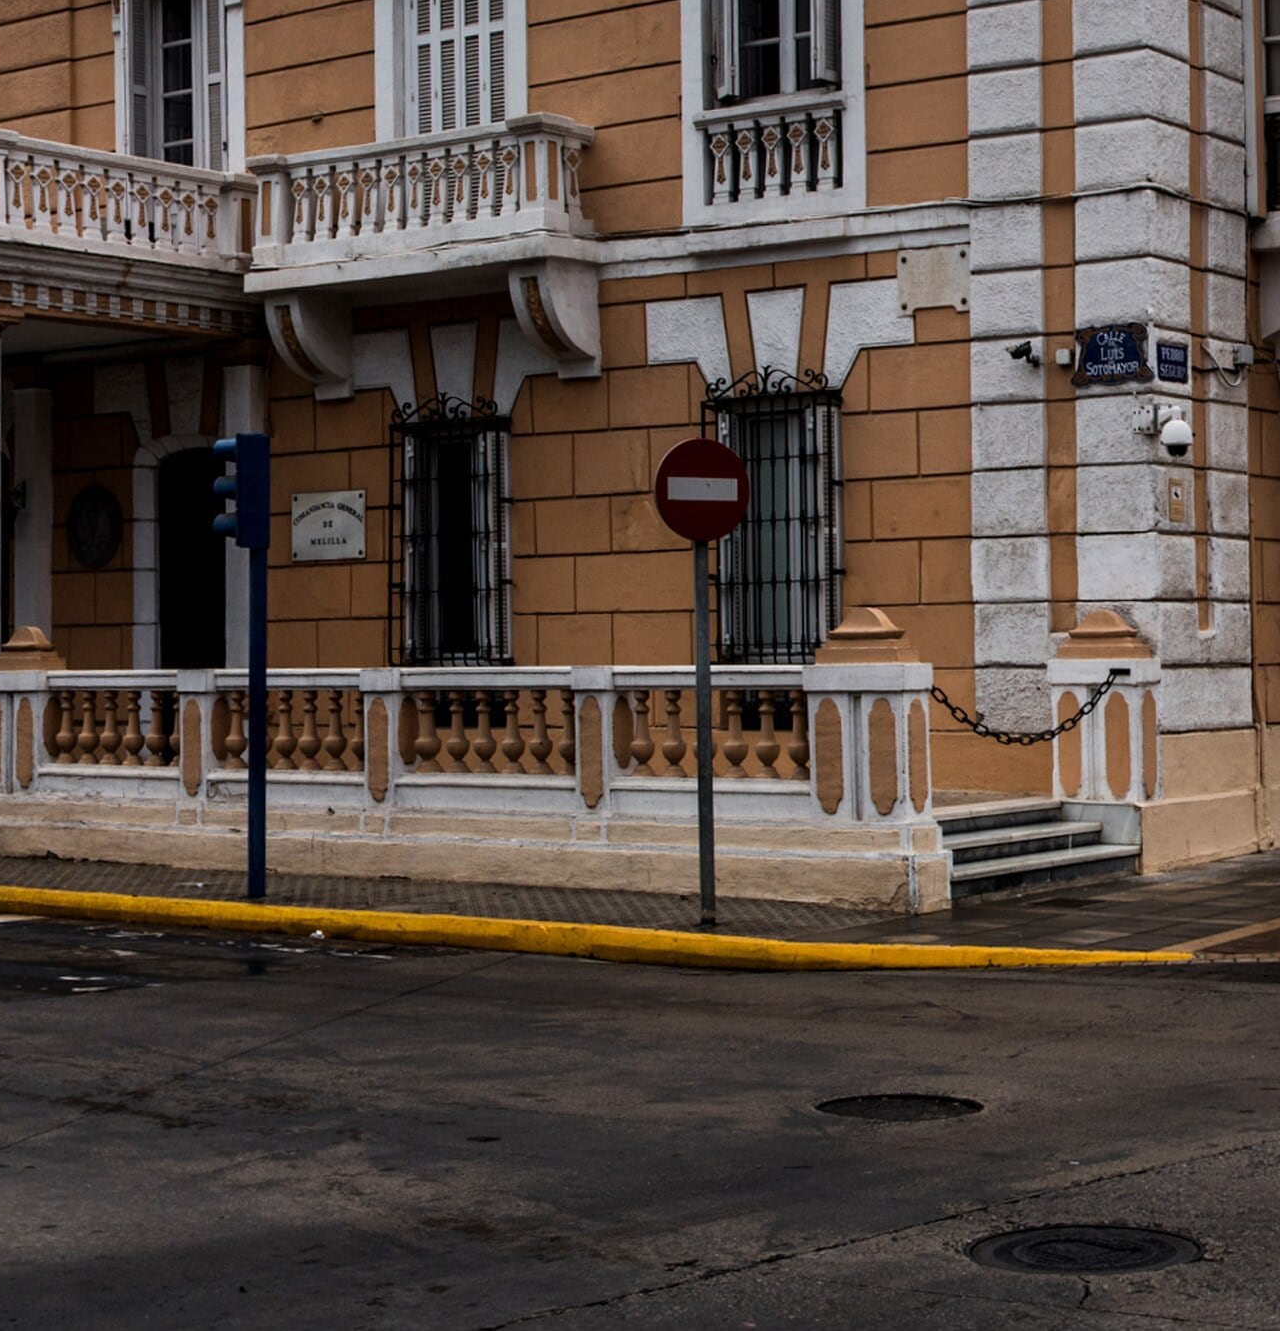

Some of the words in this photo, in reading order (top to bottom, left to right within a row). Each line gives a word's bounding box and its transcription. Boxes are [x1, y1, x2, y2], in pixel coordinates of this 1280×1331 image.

[1096, 331, 1126, 346] CALLE
[1100, 347, 1125, 361] LUIS
[1086, 361, 1140, 376] SOTOMAYOR
[293, 502, 335, 526] COMANDANCIA
[337, 502, 364, 523] GENERAL
[311, 537, 348, 545] MELILLA
